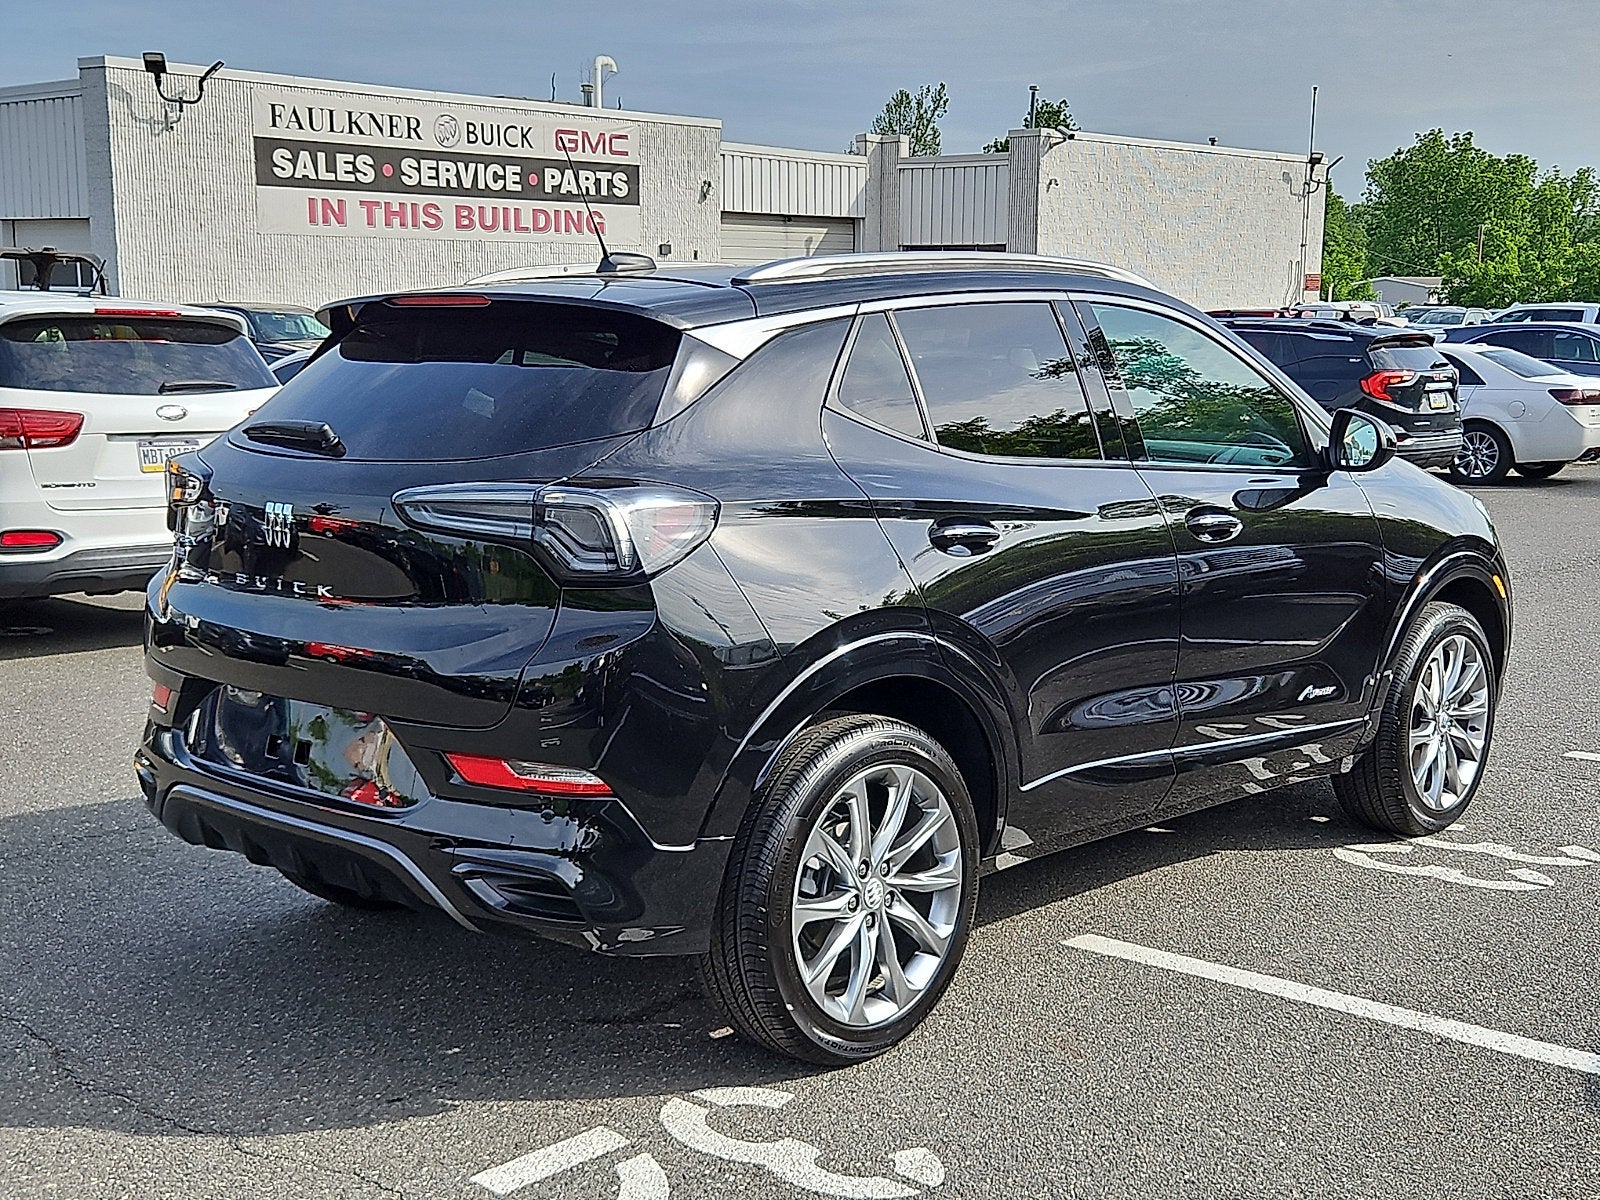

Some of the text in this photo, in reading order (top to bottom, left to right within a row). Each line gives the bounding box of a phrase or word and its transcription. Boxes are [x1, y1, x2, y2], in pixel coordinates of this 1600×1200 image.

[268, 103, 629, 156] FAULKNER BUICK GMC
[272, 148, 629, 198] SALES SERVICE PARTS
[308, 197, 607, 236] IN THIS BUILDING
[236, 573, 334, 598] BUICK
